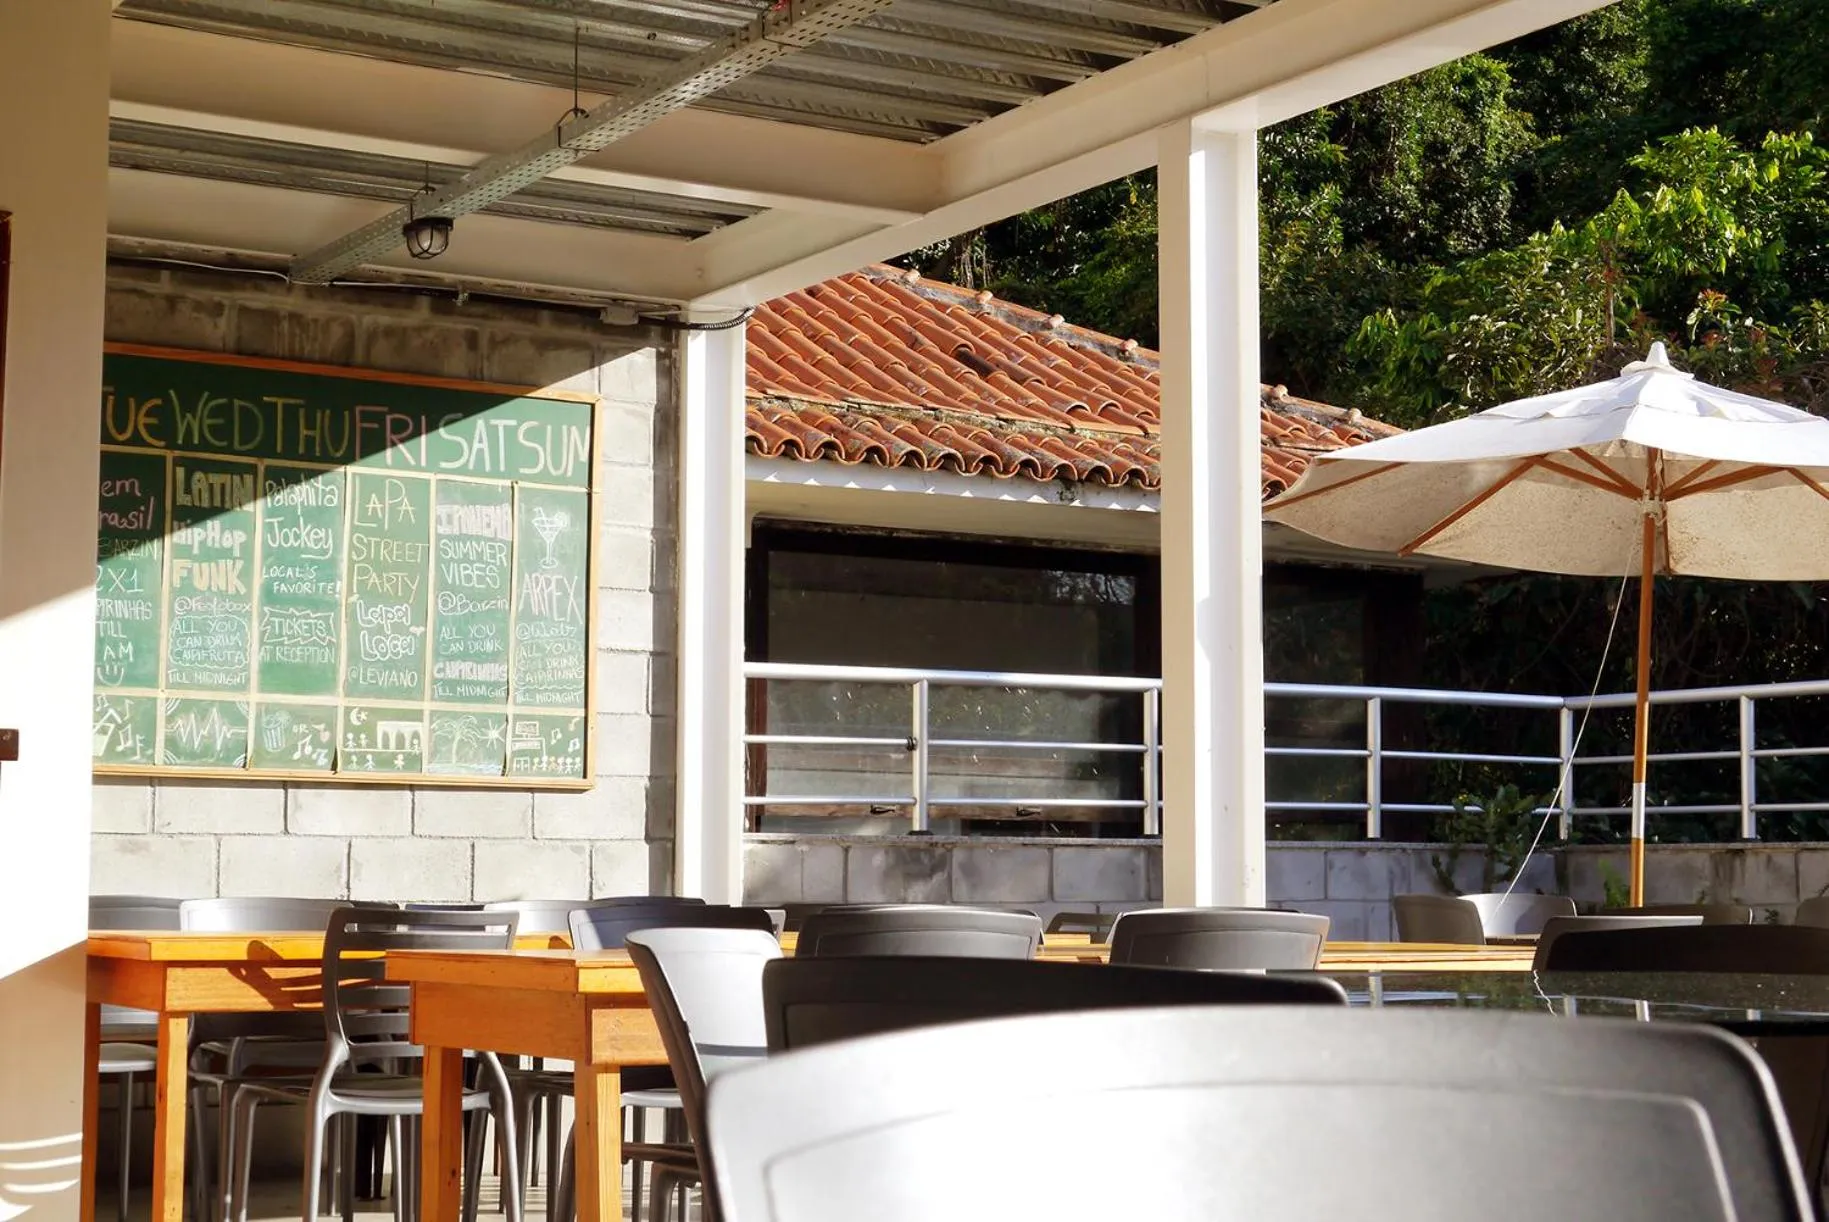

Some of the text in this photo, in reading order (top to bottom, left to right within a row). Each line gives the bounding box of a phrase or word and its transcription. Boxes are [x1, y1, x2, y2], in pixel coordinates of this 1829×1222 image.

[169, 389, 264, 451] WED
[263, 396, 349, 458] THU
[355, 405, 427, 467] FRI
[439, 413, 518, 473] SAT
[517, 420, 591, 477] SUN
[100, 478, 142, 498] em
[175, 466, 255, 513] LATIN
[354, 474, 416, 531] LAPA
[98, 496, 154, 531] rasil
[264, 515, 334, 560] Jockey
[351, 533, 430, 563] STREET
[440, 539, 507, 568] SUMMER
[173, 559, 247, 595] FUNK
[352, 563, 420, 604] PARTY
[441, 563, 500, 589] VIBES
[518, 572, 583, 625] ARPEX
[207, 618, 238, 634] YOU
[270, 617, 327, 637] TICKETS
[439, 623, 496, 642] ALL YOU
[276, 646, 335, 665] RECEPTION
